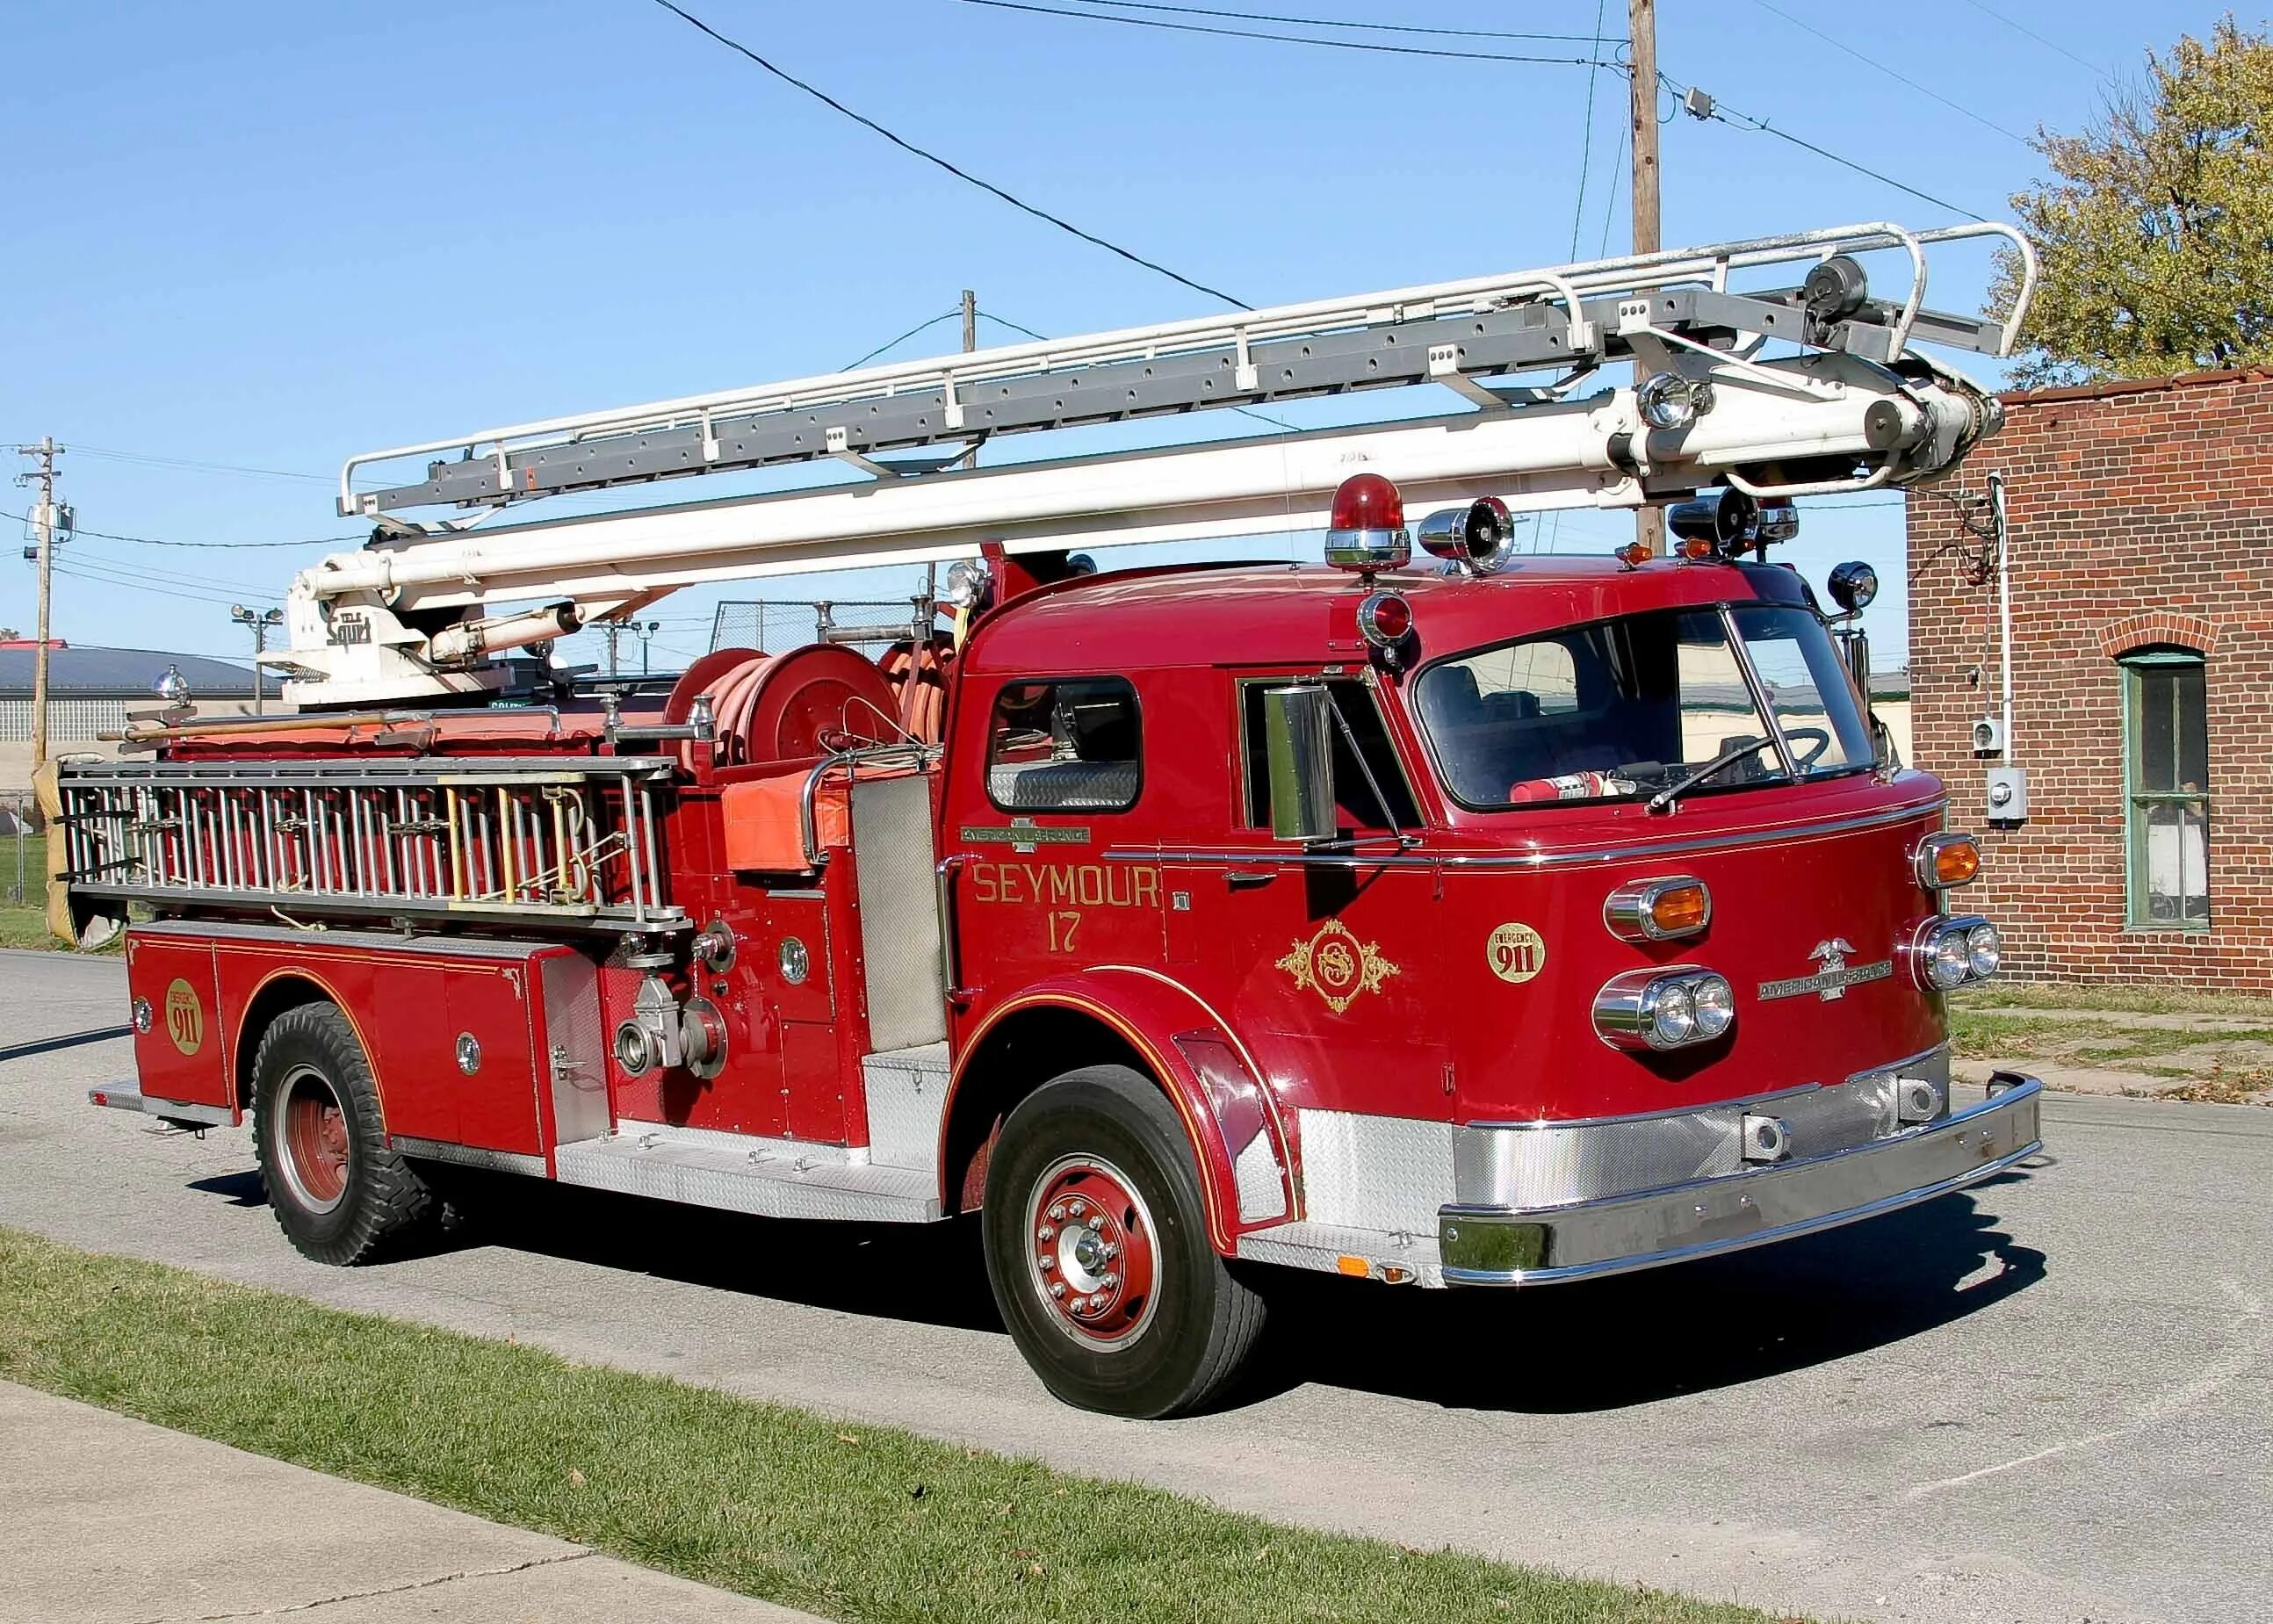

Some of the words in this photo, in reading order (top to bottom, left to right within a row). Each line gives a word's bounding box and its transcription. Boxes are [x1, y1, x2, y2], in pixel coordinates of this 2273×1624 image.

[340, 612, 362, 623] TELE
[972, 863, 1159, 908] SEYMOUR
[1047, 911, 1081, 953] 17
[1495, 933, 1533, 943] EMERGENCY
[1497, 945, 1536, 974] 911
[1760, 972, 1834, 999] AMERICAN
[173, 1007, 198, 1043] 911
